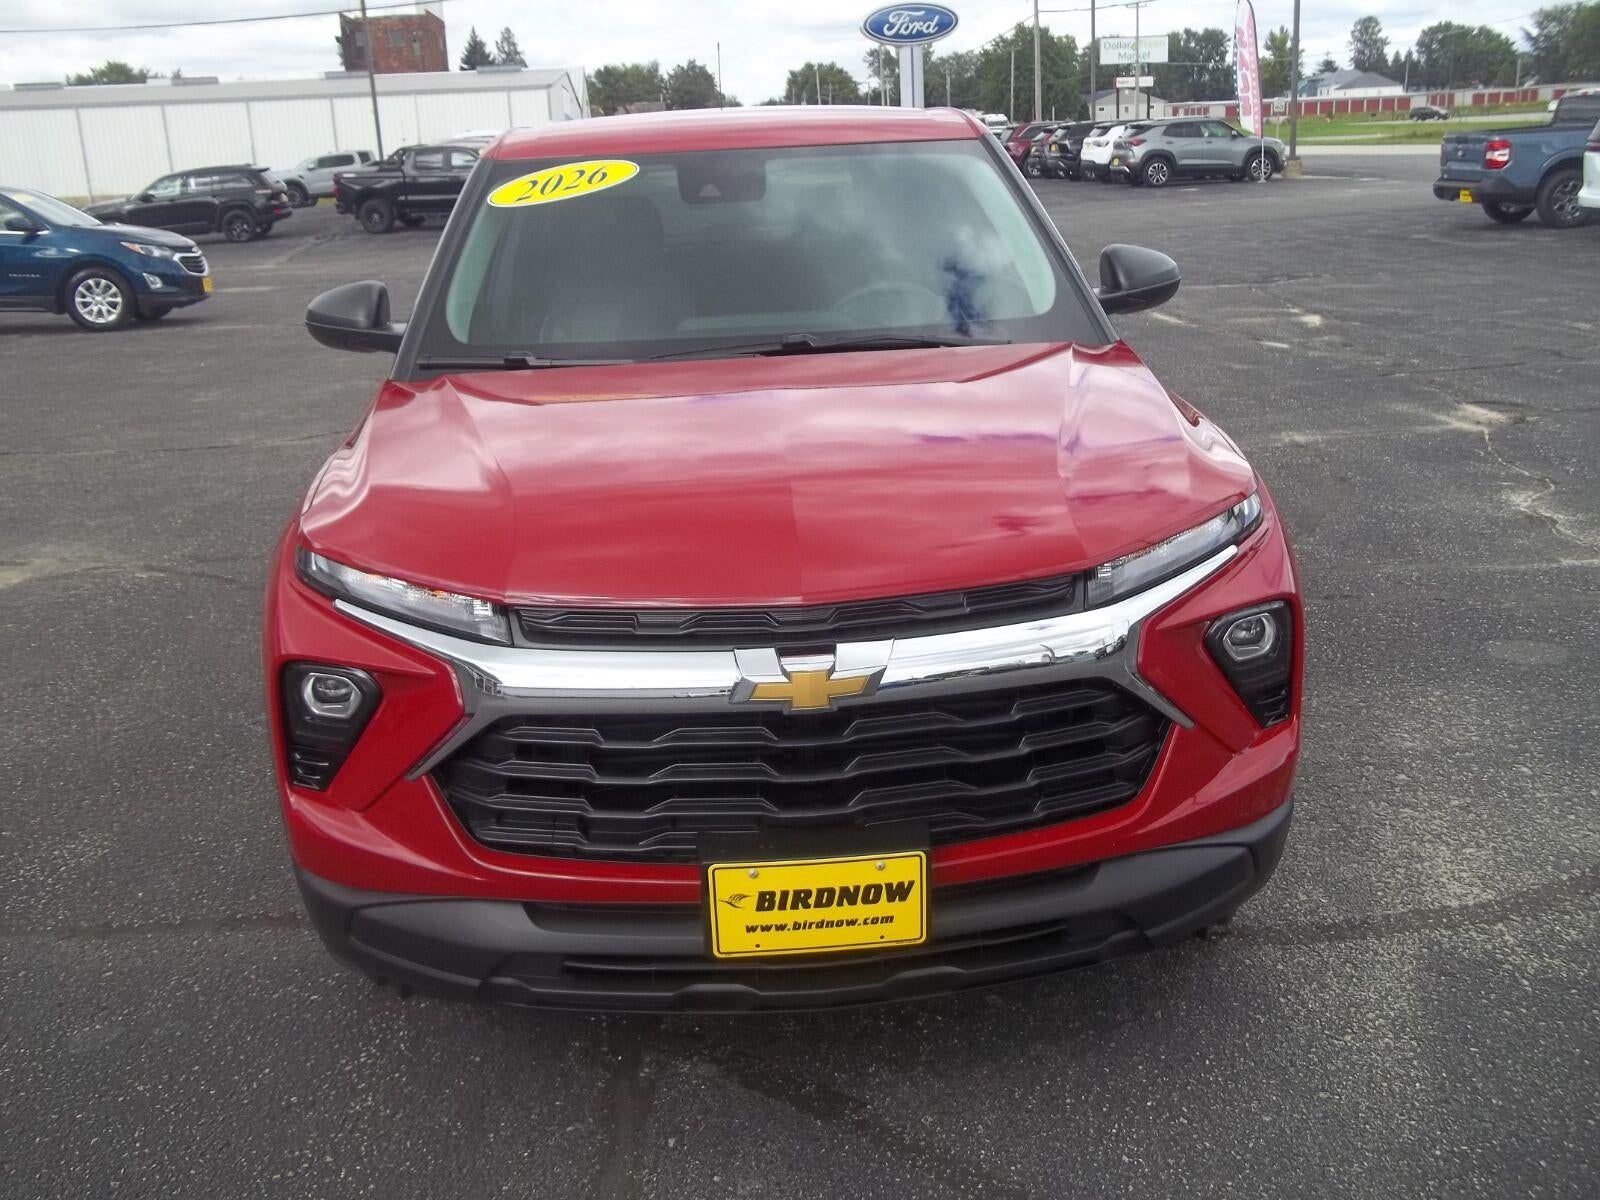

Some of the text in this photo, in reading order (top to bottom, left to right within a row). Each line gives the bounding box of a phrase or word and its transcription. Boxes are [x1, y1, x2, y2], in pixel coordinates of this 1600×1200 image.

[883, 10, 940, 36] Ford
[1103, 41, 1131, 50] Dollar
[515, 164, 609, 202] 2026
[755, 879, 915, 912] BIRDNOW
[745, 914, 895, 934] www.birdnow.com
